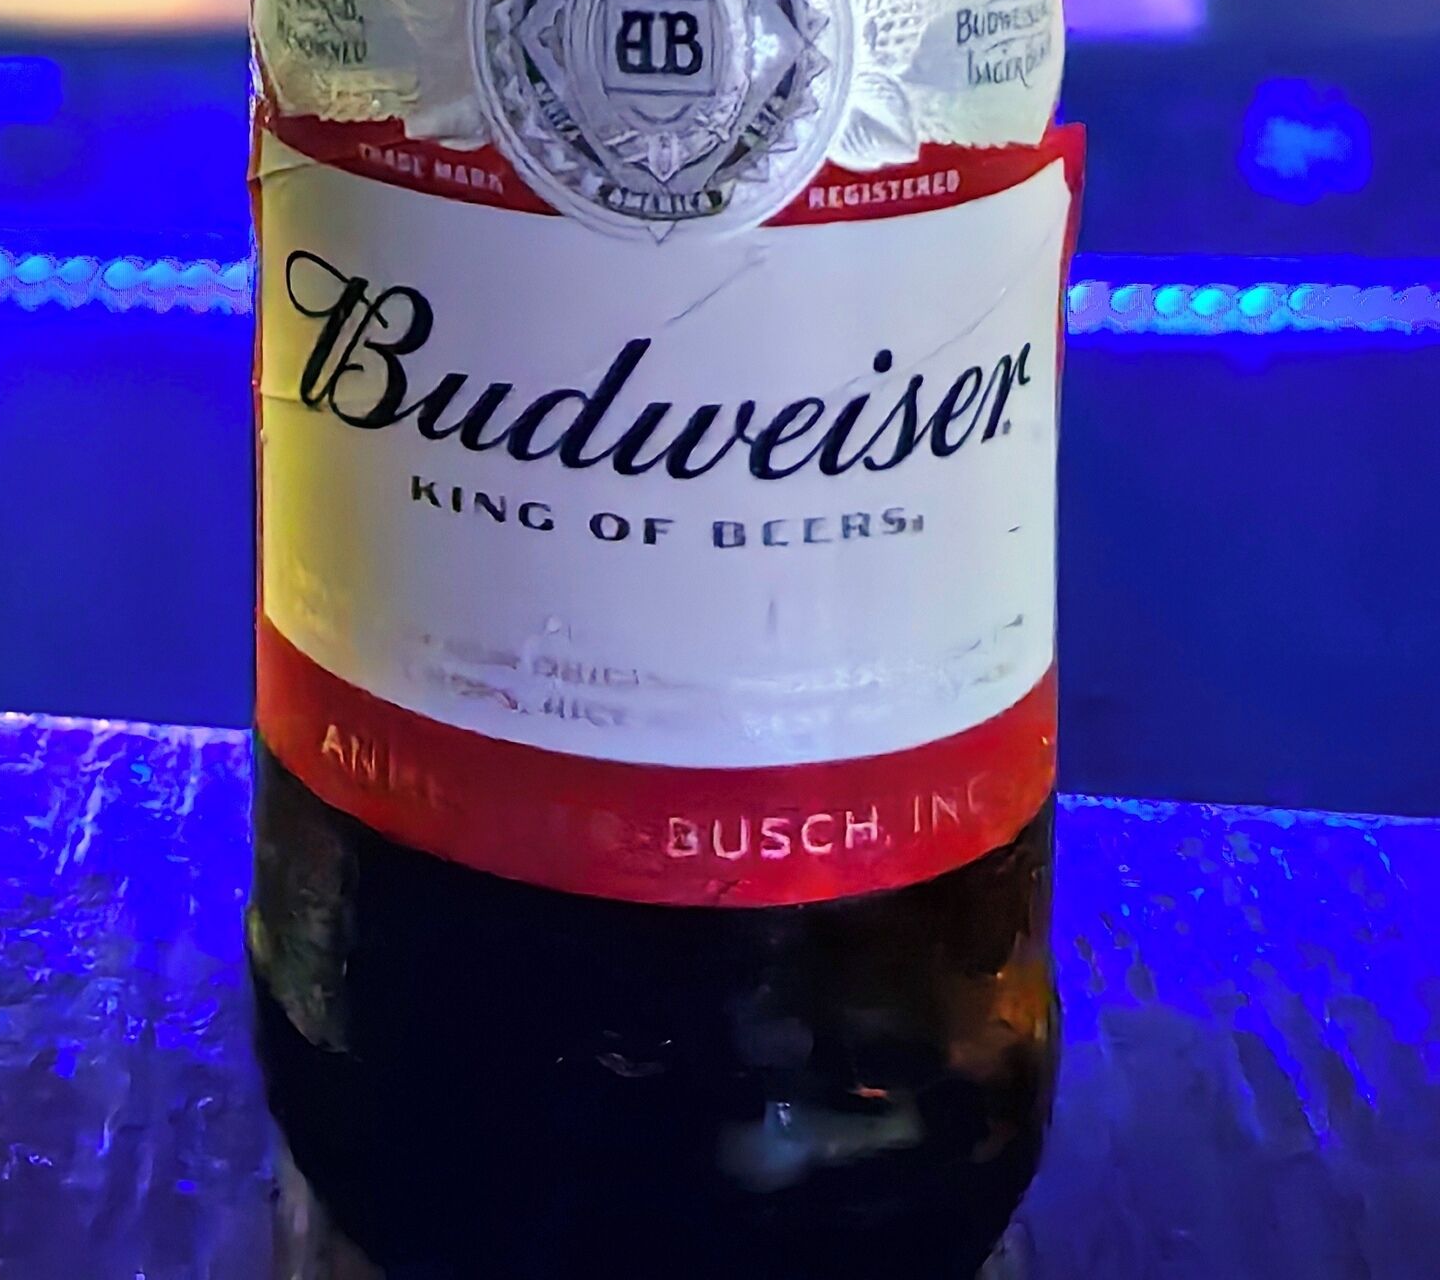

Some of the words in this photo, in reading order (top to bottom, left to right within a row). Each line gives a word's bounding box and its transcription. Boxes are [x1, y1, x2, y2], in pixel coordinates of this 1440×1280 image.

[808, 168, 961, 211] REGISTERED
[286, 250, 1032, 481] Budweiser
[410, 474, 556, 532] KING
[588, 511, 676, 547] OF
